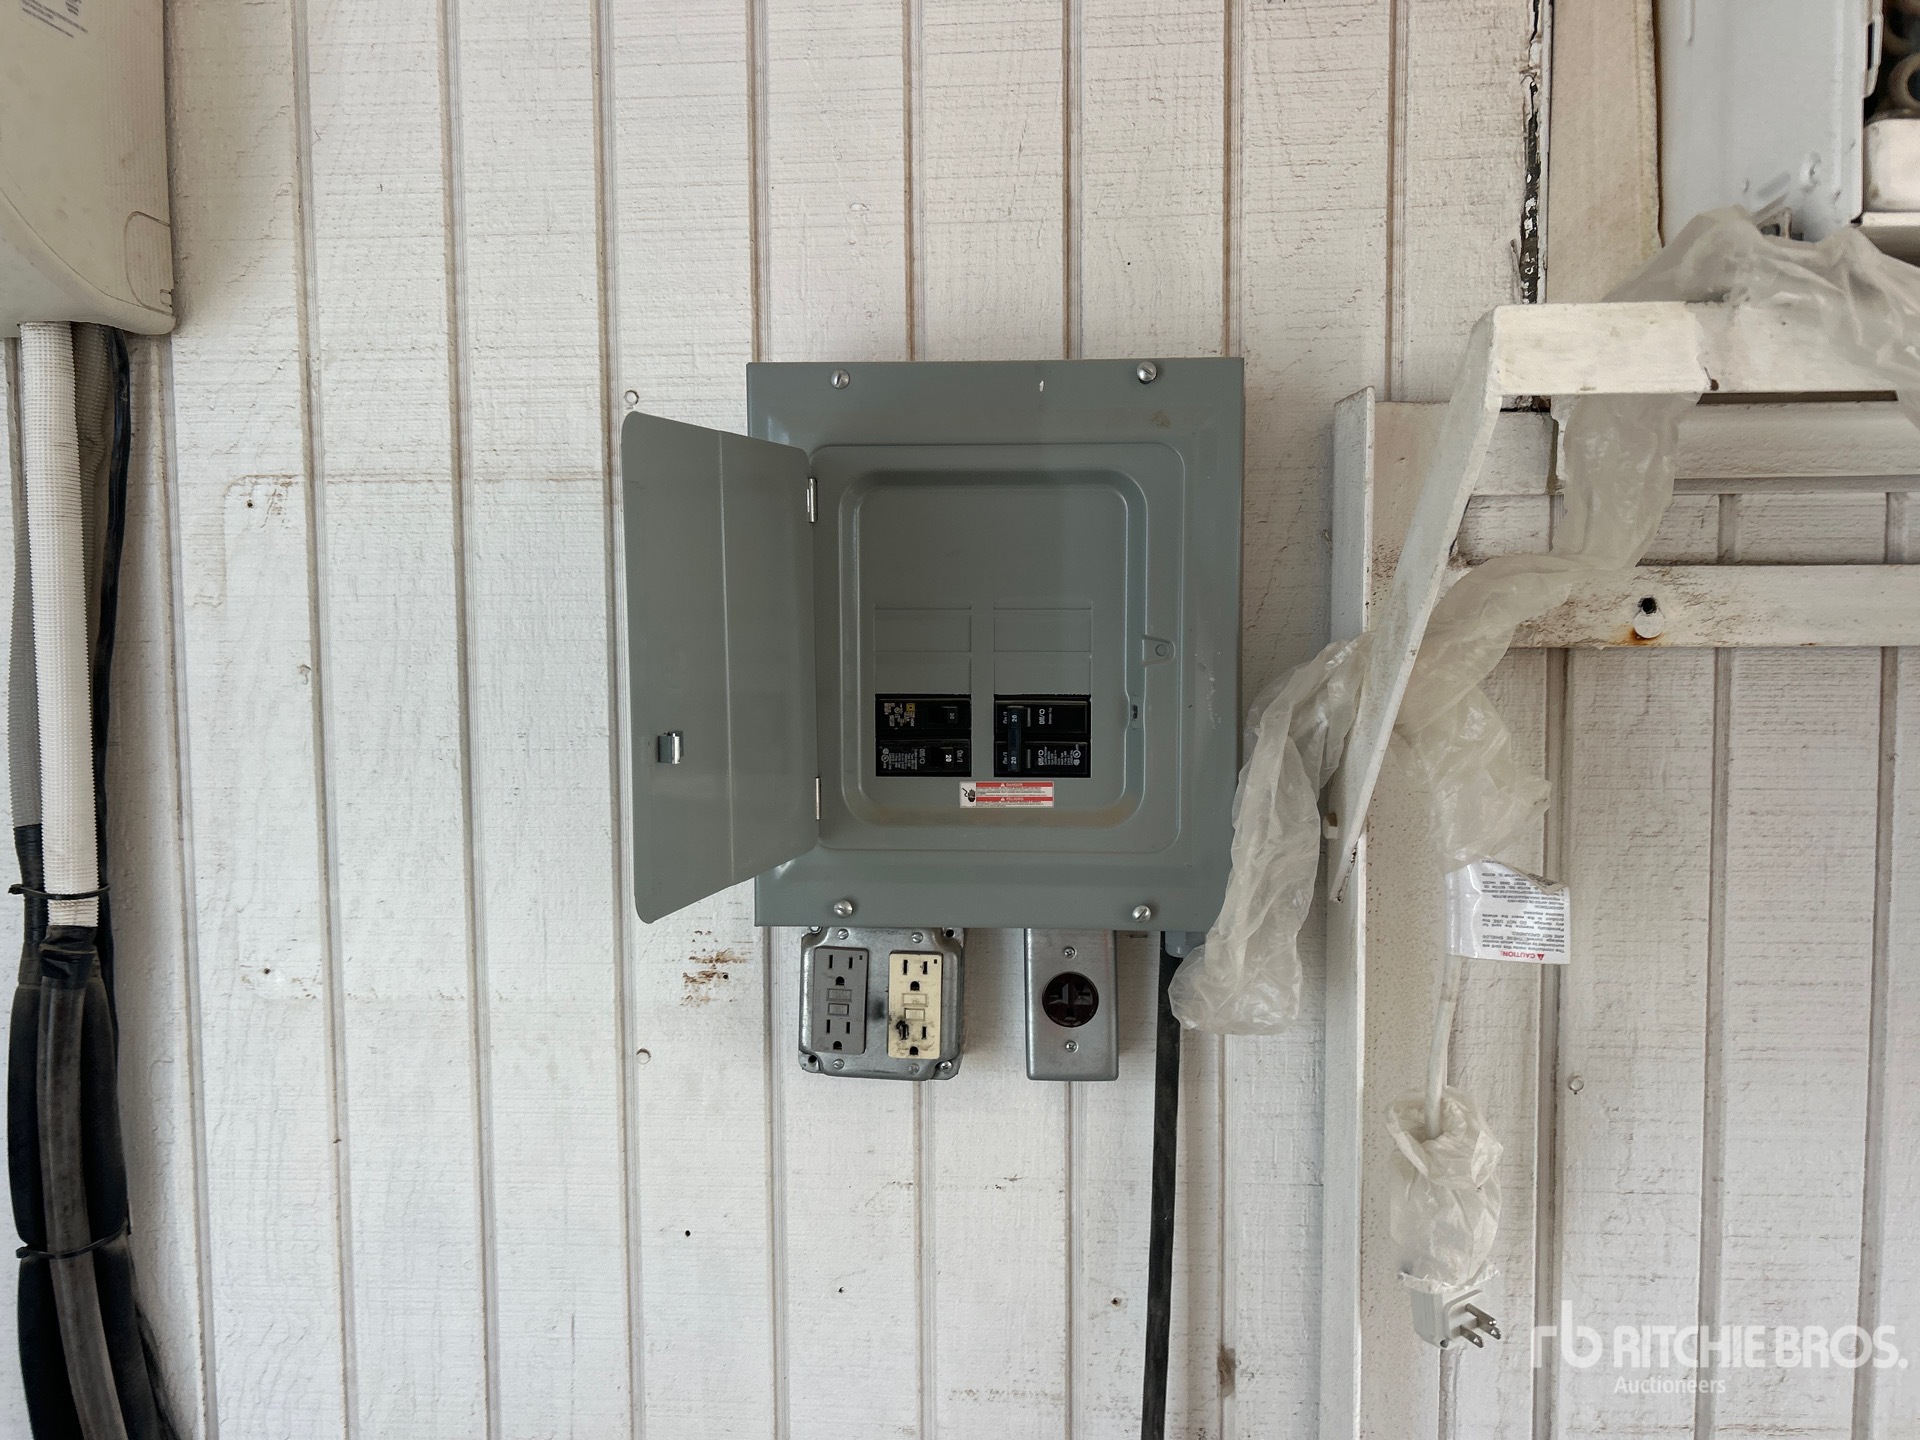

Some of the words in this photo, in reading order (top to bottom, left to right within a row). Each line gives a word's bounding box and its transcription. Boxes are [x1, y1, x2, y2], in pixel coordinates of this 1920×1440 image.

[945, 754, 952, 762] 20
[1011, 756, 1016, 764] 20
[1500, 951, 1535, 959] CAUTION:
